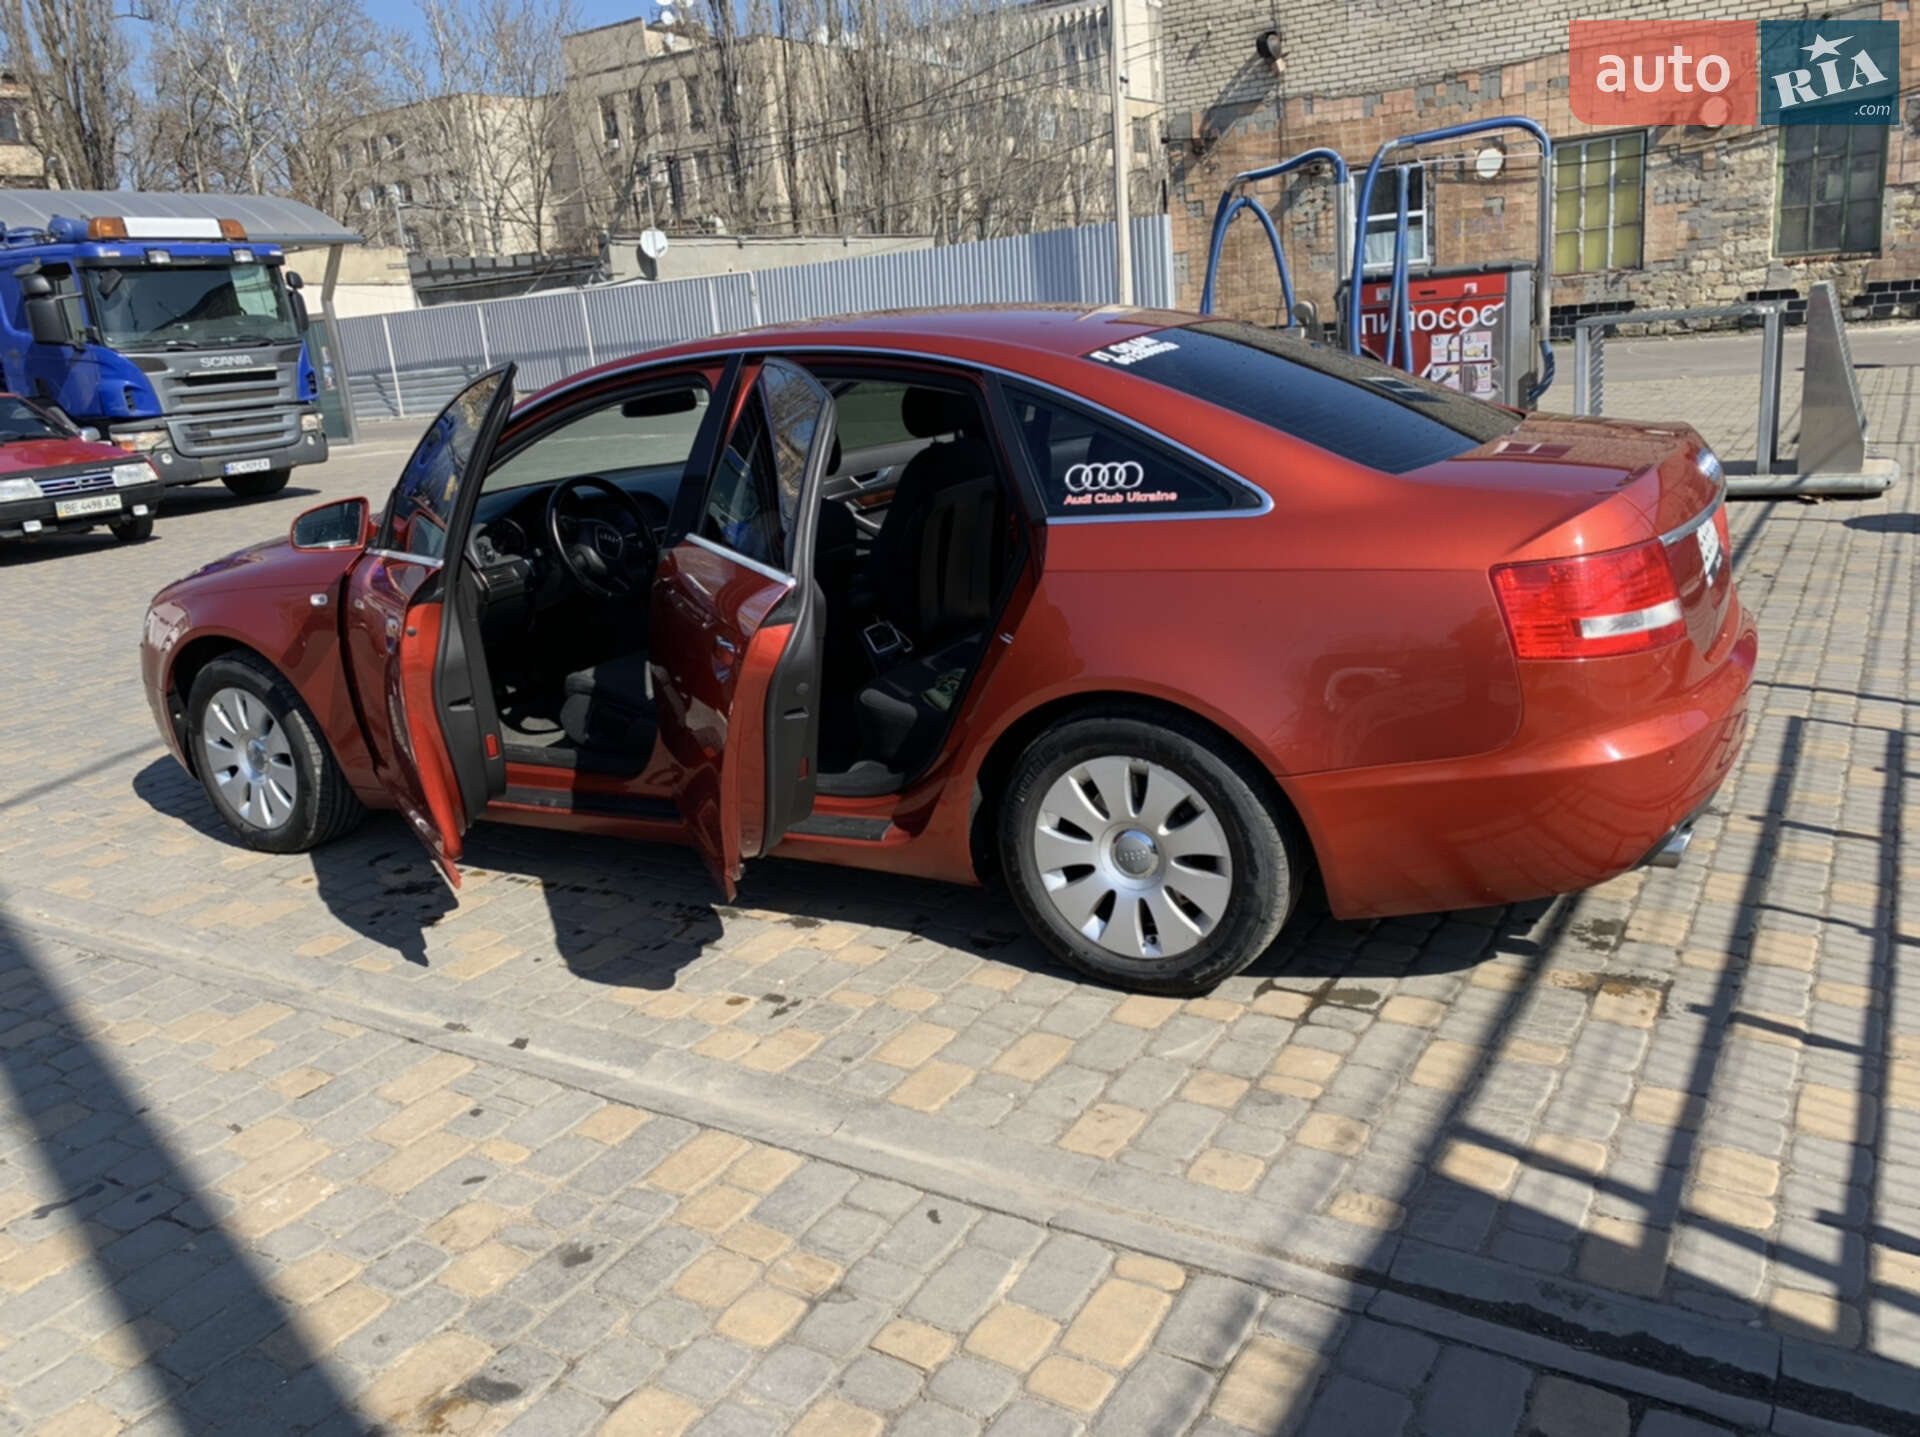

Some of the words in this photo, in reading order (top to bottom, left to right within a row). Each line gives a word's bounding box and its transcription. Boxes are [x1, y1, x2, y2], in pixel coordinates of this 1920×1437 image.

[199, 354, 254, 368] SCANIA
[1064, 494, 1093, 505] Audi
[1094, 492, 1125, 504] Club
[1126, 490, 1178, 503] Ukraine
